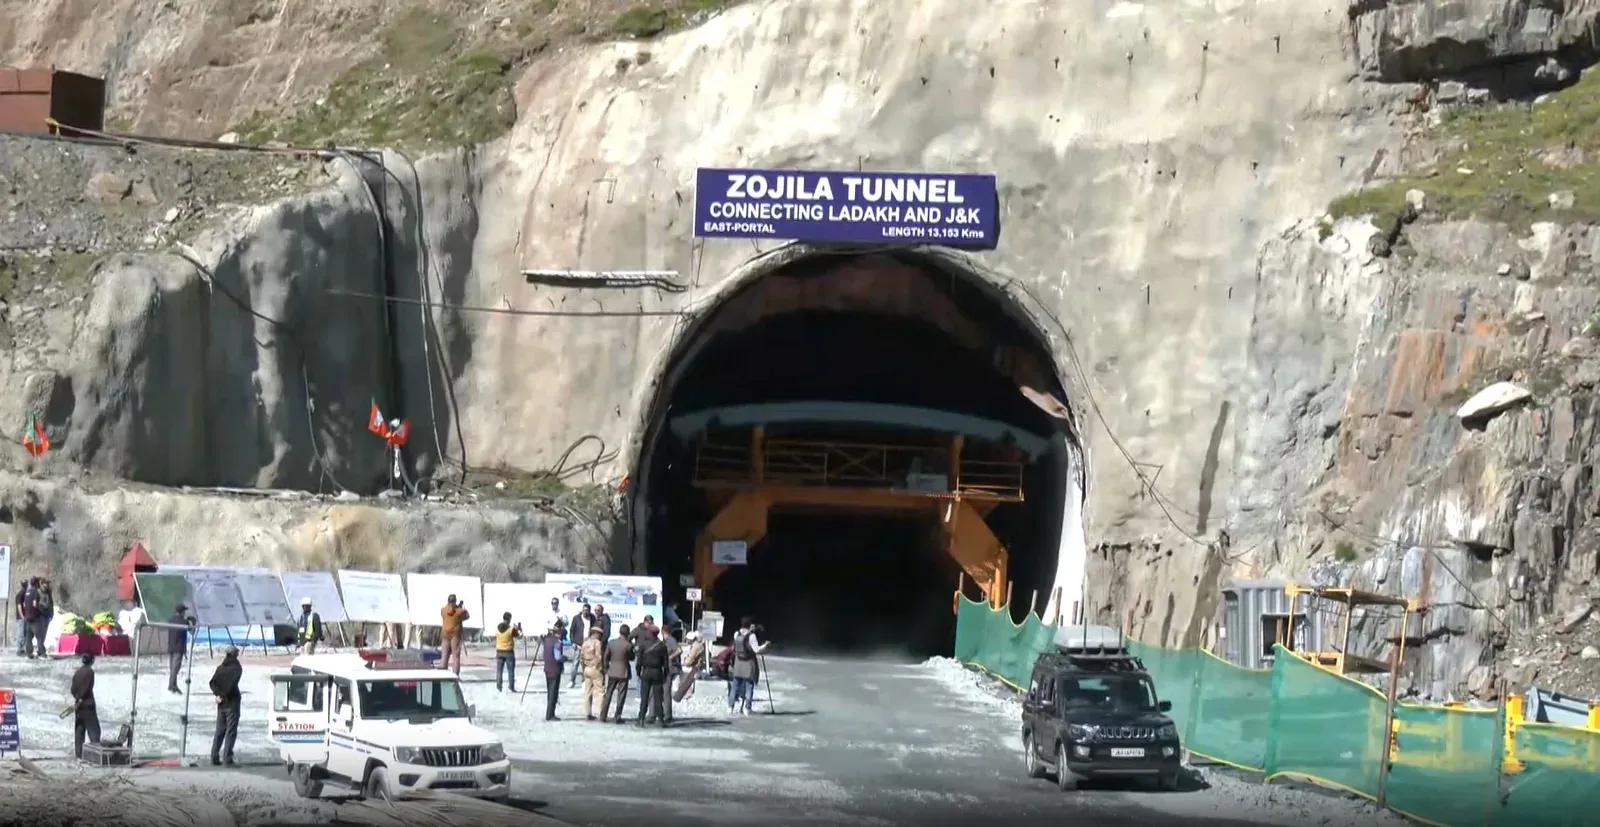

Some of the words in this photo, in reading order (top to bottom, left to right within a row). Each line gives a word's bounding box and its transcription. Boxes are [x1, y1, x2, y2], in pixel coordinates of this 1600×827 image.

[726, 174, 834, 200] ZOJILA
[842, 177, 965, 203] TUNNEL
[709, 202, 824, 221] CONNECTING
[828, 205, 900, 222] LADAKH
[904, 206, 942, 224] AND
[945, 207, 981, 225] J&K
[704, 221, 776, 234] EAST-PORTAL
[882, 226, 925, 238] LENGTH
[961, 228, 985, 239] Kms
[278, 722, 315, 731] STATION
